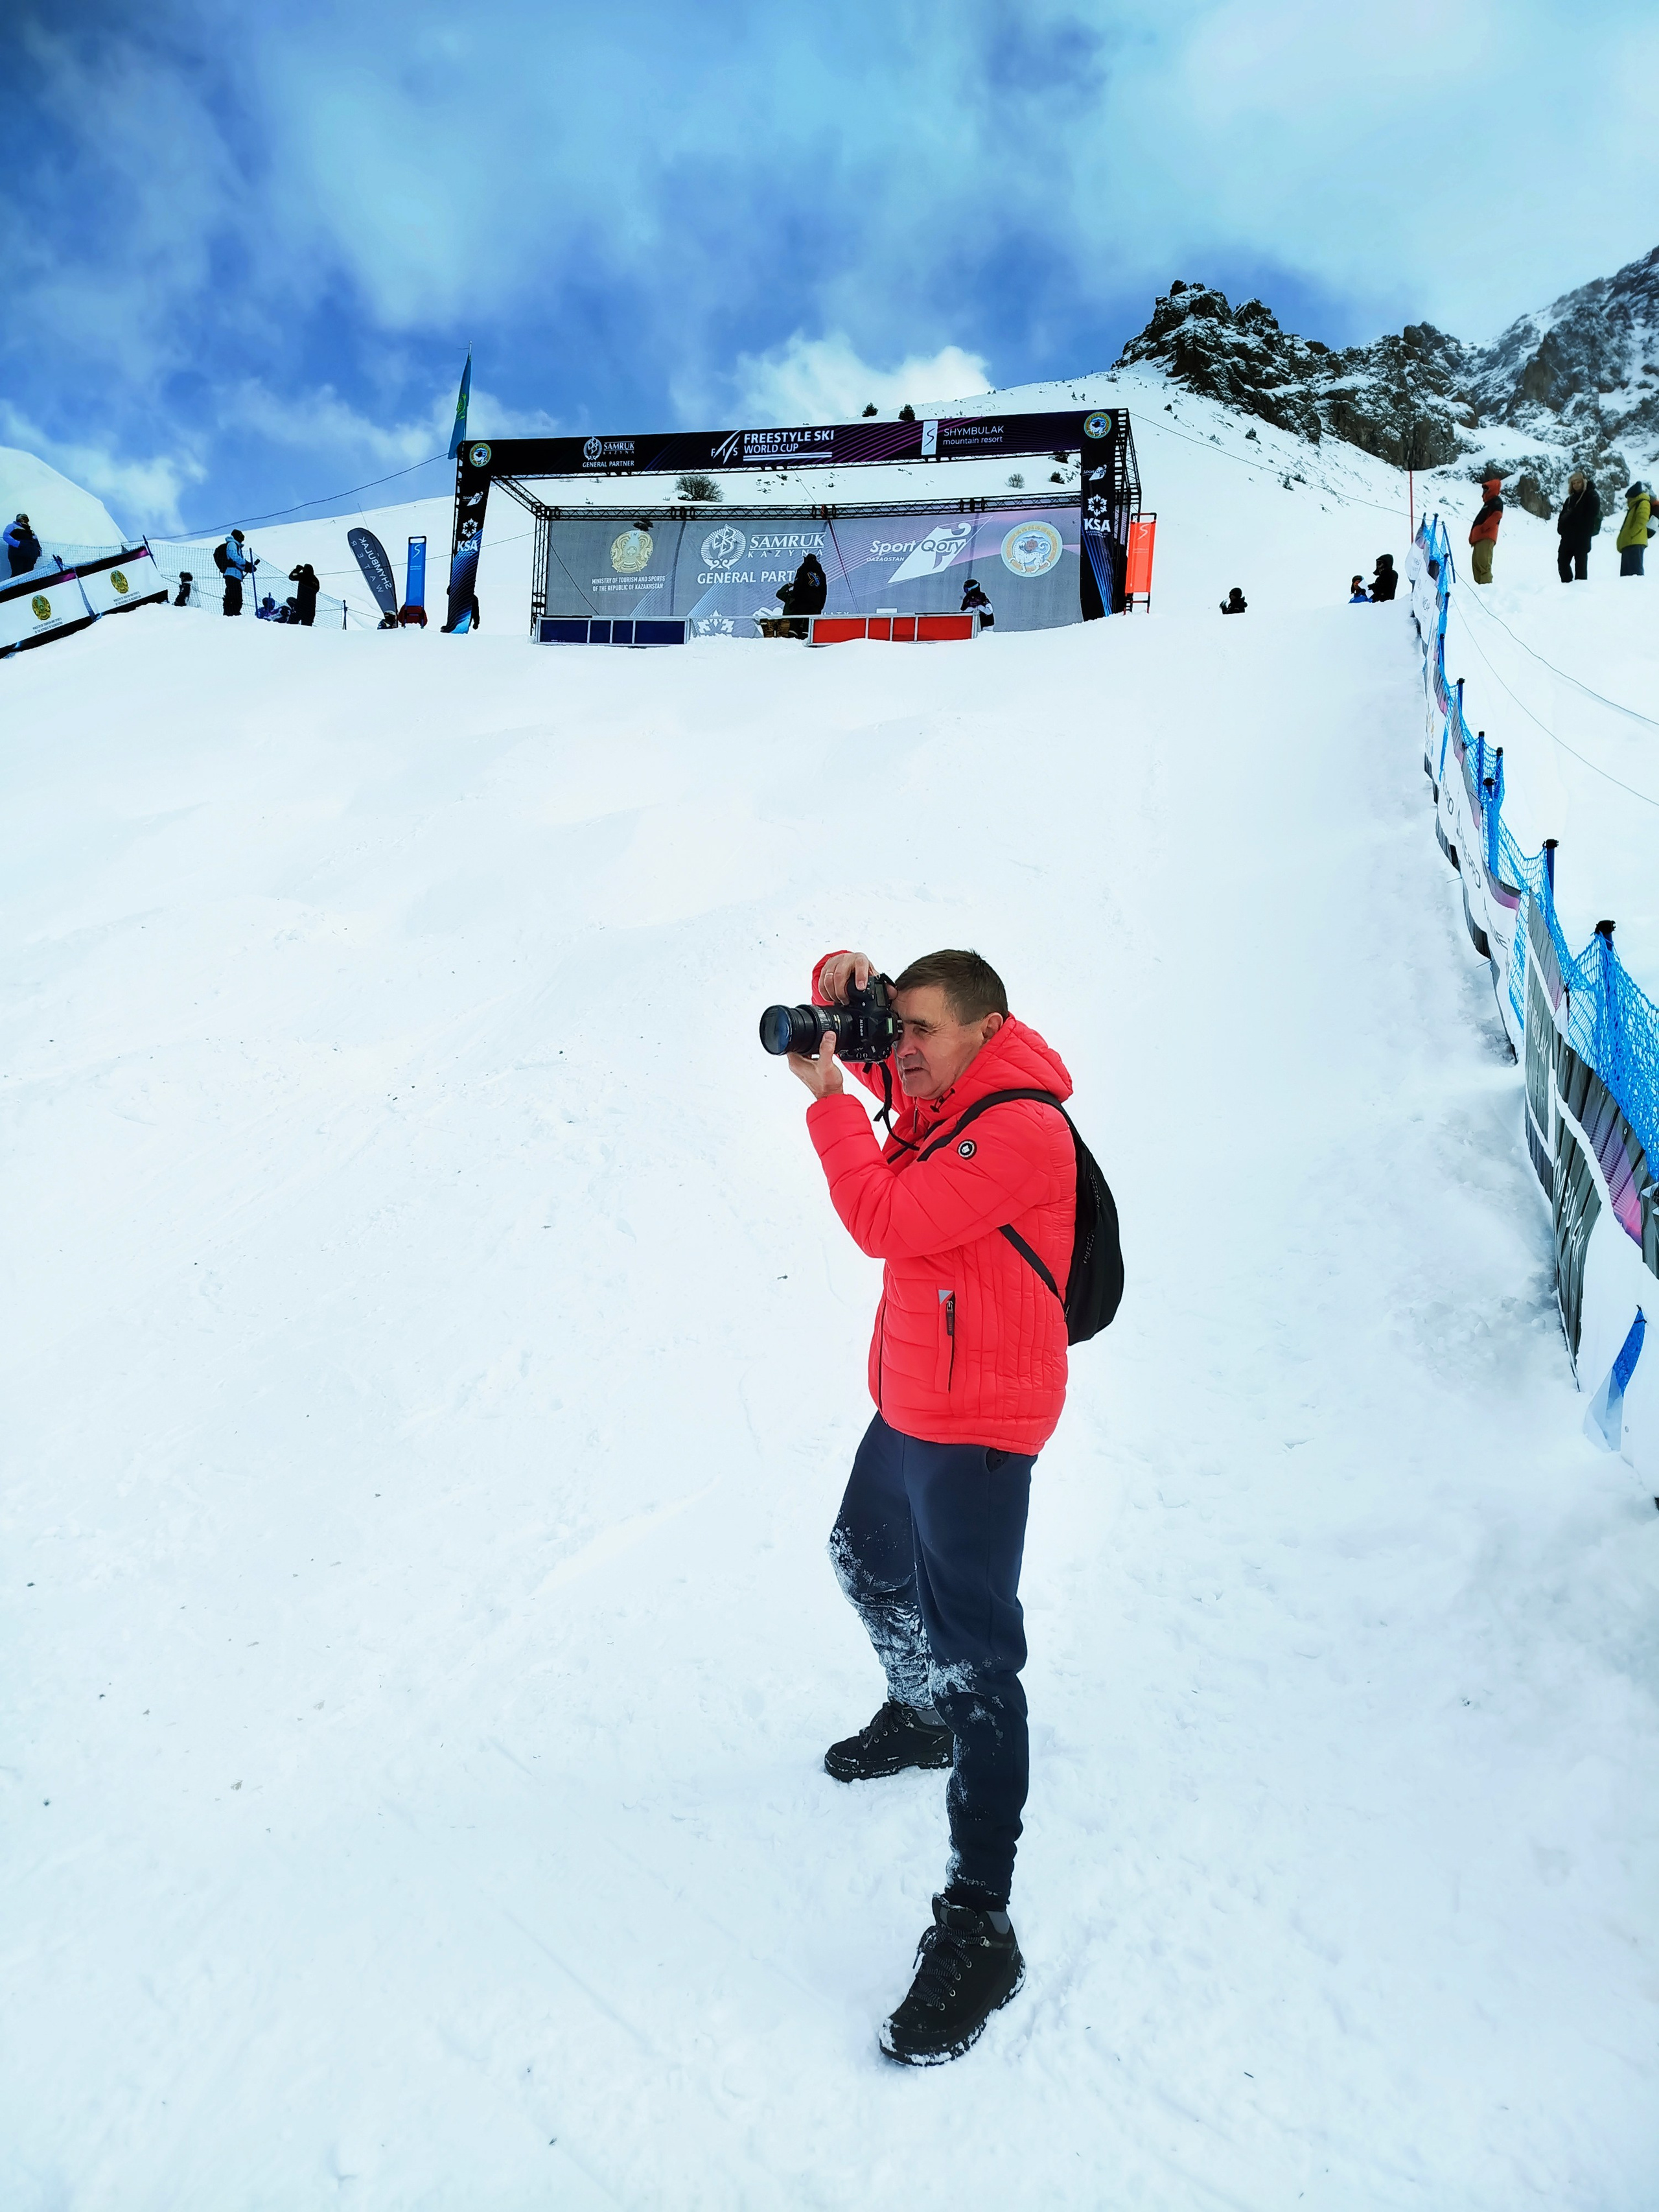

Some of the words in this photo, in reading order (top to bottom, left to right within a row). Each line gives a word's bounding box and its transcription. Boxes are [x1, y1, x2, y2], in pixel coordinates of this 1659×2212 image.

[744, 431, 811, 444] FREESTYLE
[814, 430, 835, 441] SKI
[944, 425, 1004, 436] SHYMBULAK
[943, 437, 979, 445] mountain
[744, 444, 779, 454] WORLD
[780, 443, 798, 452] CUP
[1084, 518, 1111, 532] KSA
[457, 539, 478, 552] KSA
[749, 534, 826, 548] SAMRUK
[870, 540, 916, 555] Sport
[921, 539, 966, 554] Qory
[747, 548, 823, 558] KAZYNA
[697, 571, 756, 584] GENERAL
[761, 570, 796, 583] PART
